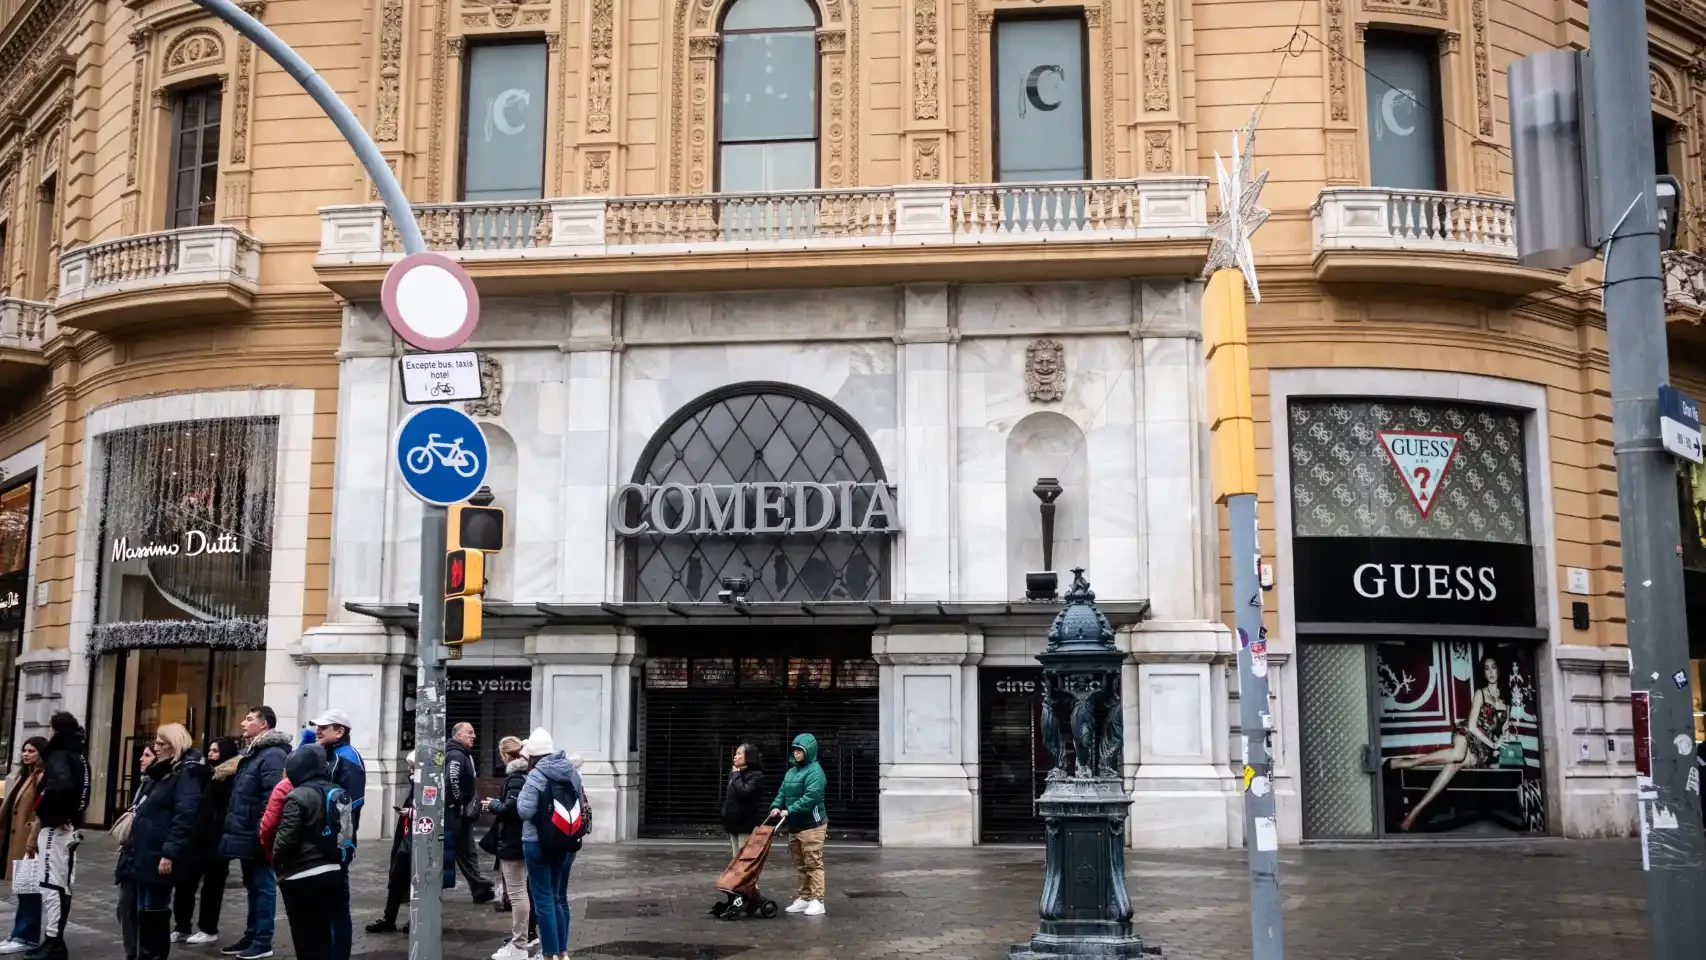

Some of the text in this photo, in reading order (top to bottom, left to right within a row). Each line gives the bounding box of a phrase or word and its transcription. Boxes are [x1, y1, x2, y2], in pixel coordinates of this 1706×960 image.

[405, 361, 436, 370] Excepte
[456, 359, 474, 368] taxis
[430, 371, 449, 380] hotel
[1391, 438, 1449, 458] GUESS
[609, 479, 900, 536] COMEDIA
[111, 530, 241, 562] Massimo Dutti
[1353, 563, 1497, 602] GUESS
[996, 676, 1036, 692] cine
